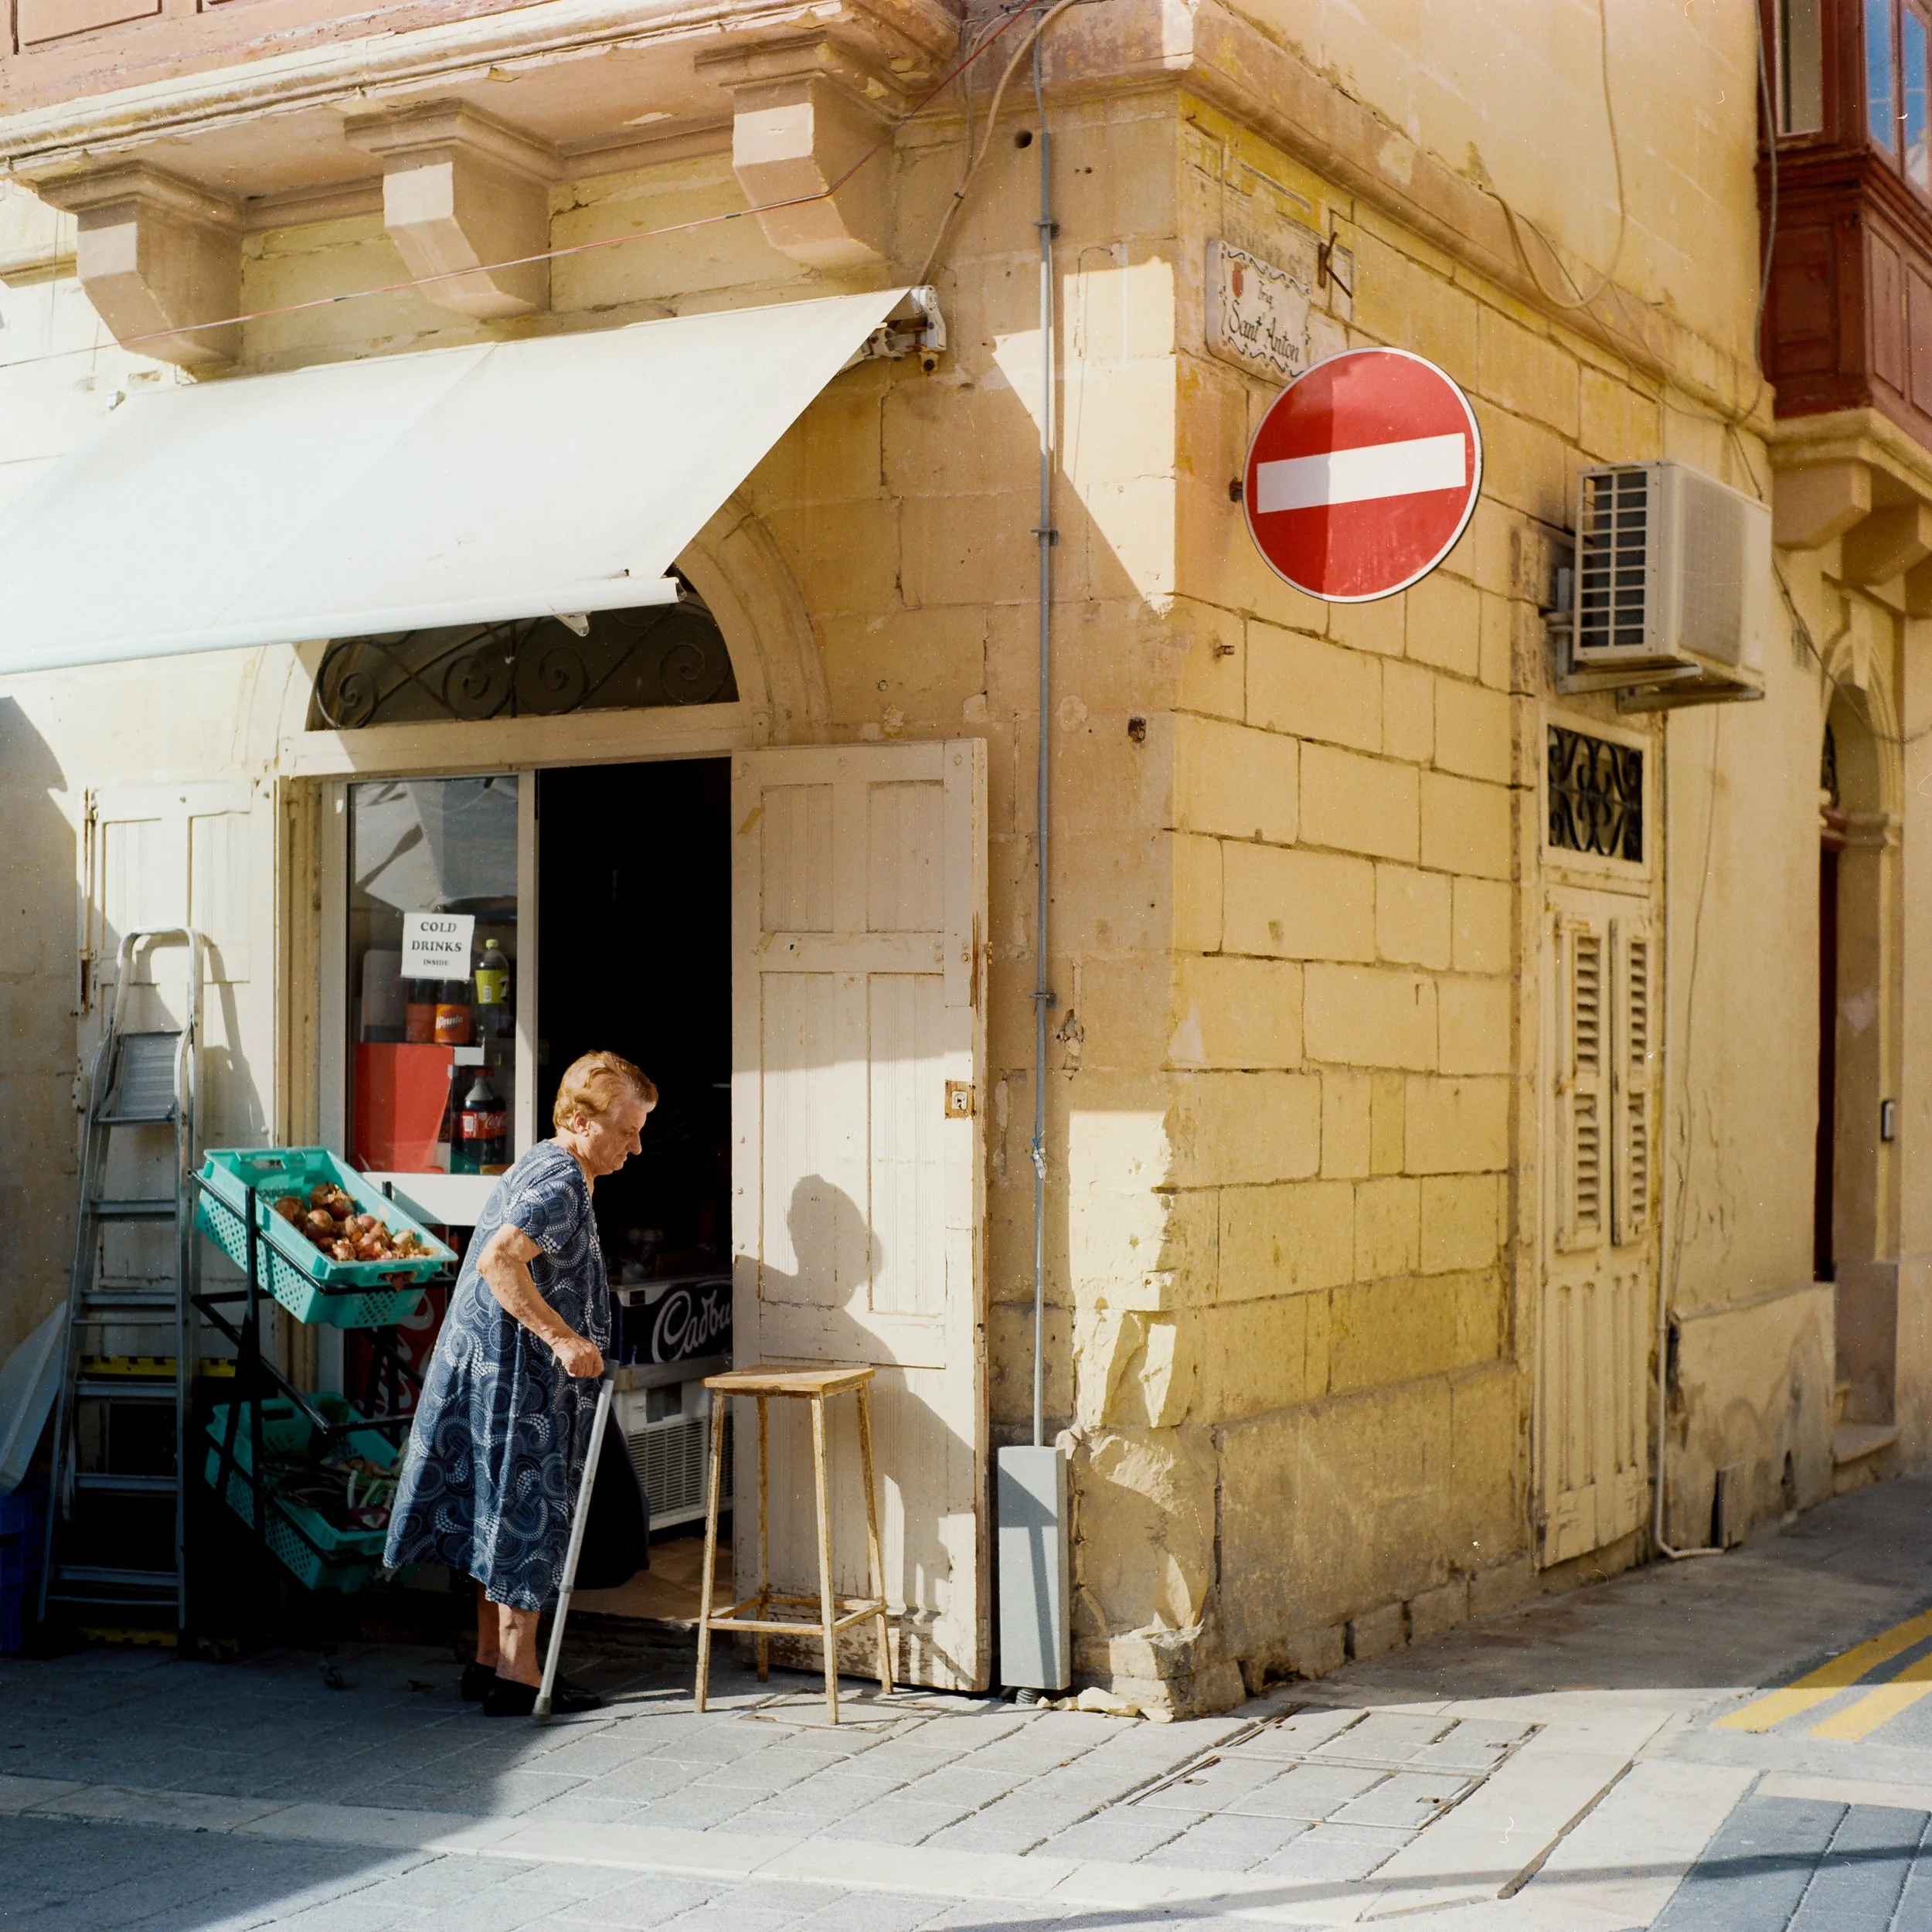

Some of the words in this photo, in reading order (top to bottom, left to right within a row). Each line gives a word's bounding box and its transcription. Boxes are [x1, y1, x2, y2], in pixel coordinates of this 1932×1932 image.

[420, 921, 457, 934] COLD
[411, 940, 462, 953] DRINKS
[423, 958, 450, 967] INSIDE
[651, 1288, 733, 1363] Cadbu
